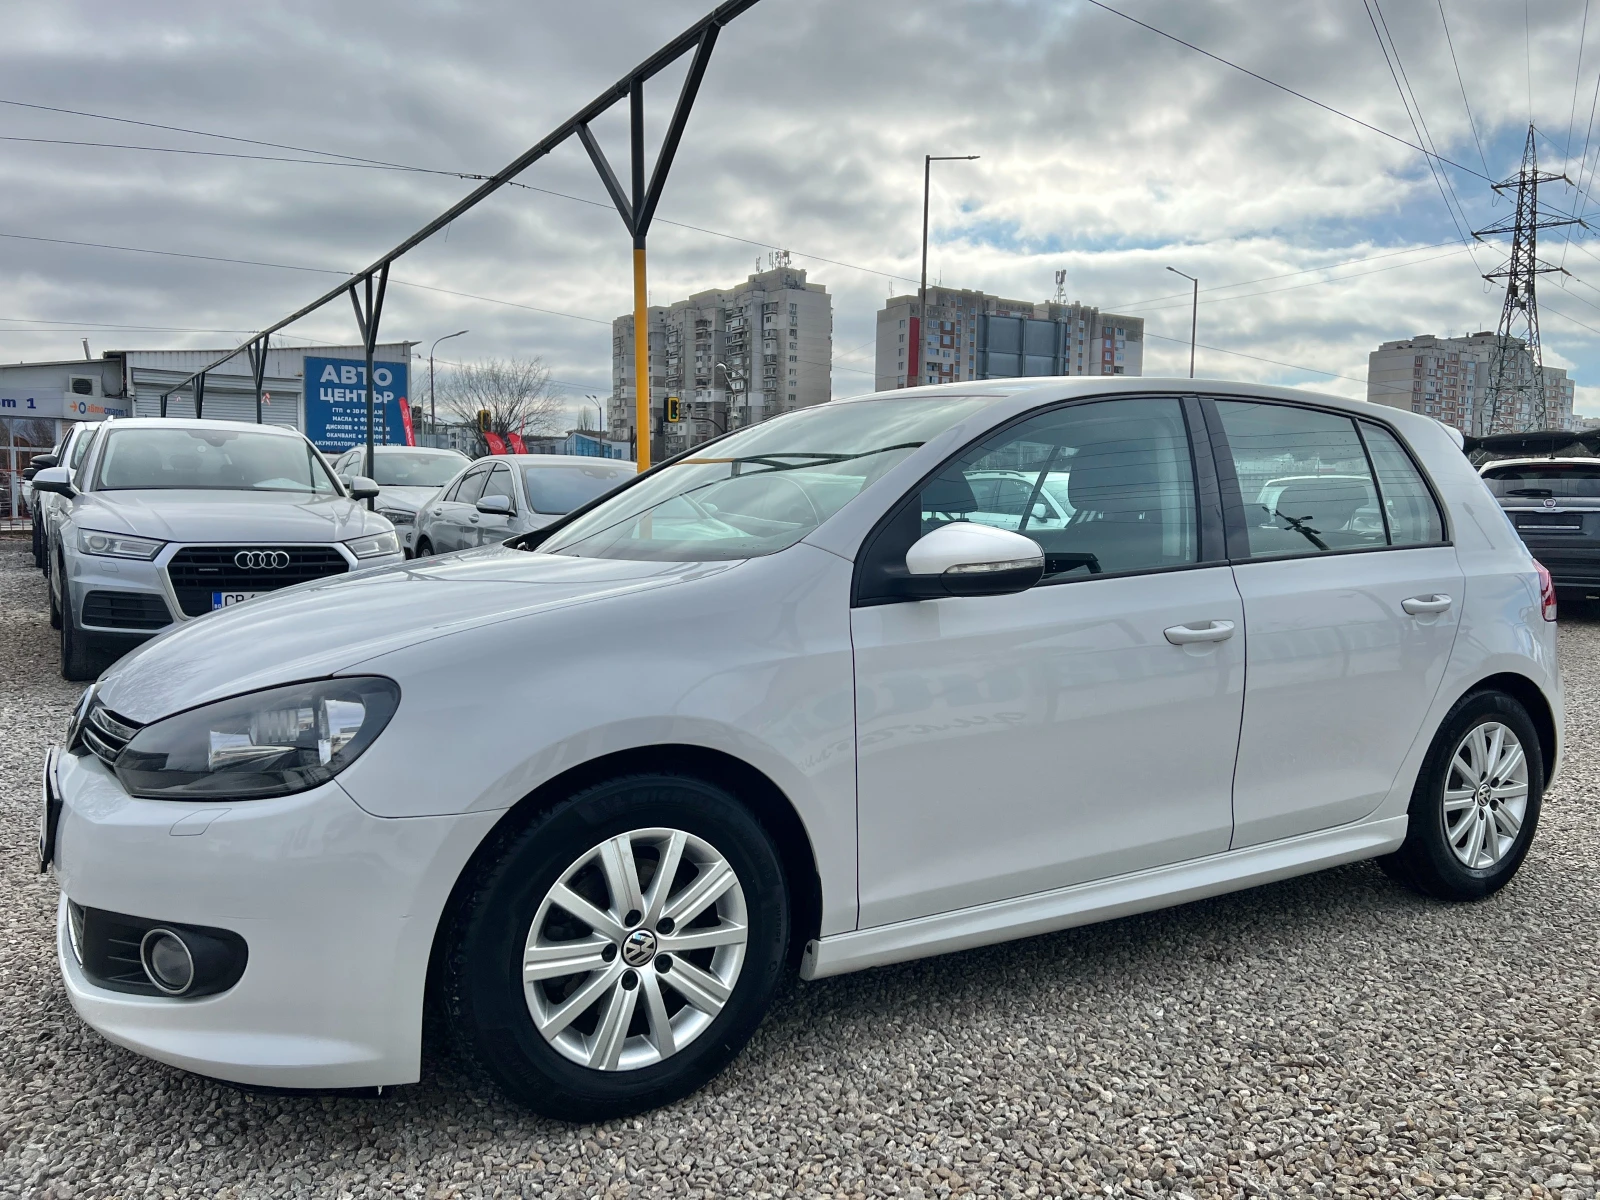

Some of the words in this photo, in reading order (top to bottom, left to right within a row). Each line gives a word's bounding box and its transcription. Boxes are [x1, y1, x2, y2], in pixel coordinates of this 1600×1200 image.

[320, 365, 393, 387] АВТО
[26, 397, 37, 409] 1
[320, 388, 394, 404] ЦЕНТЪР
